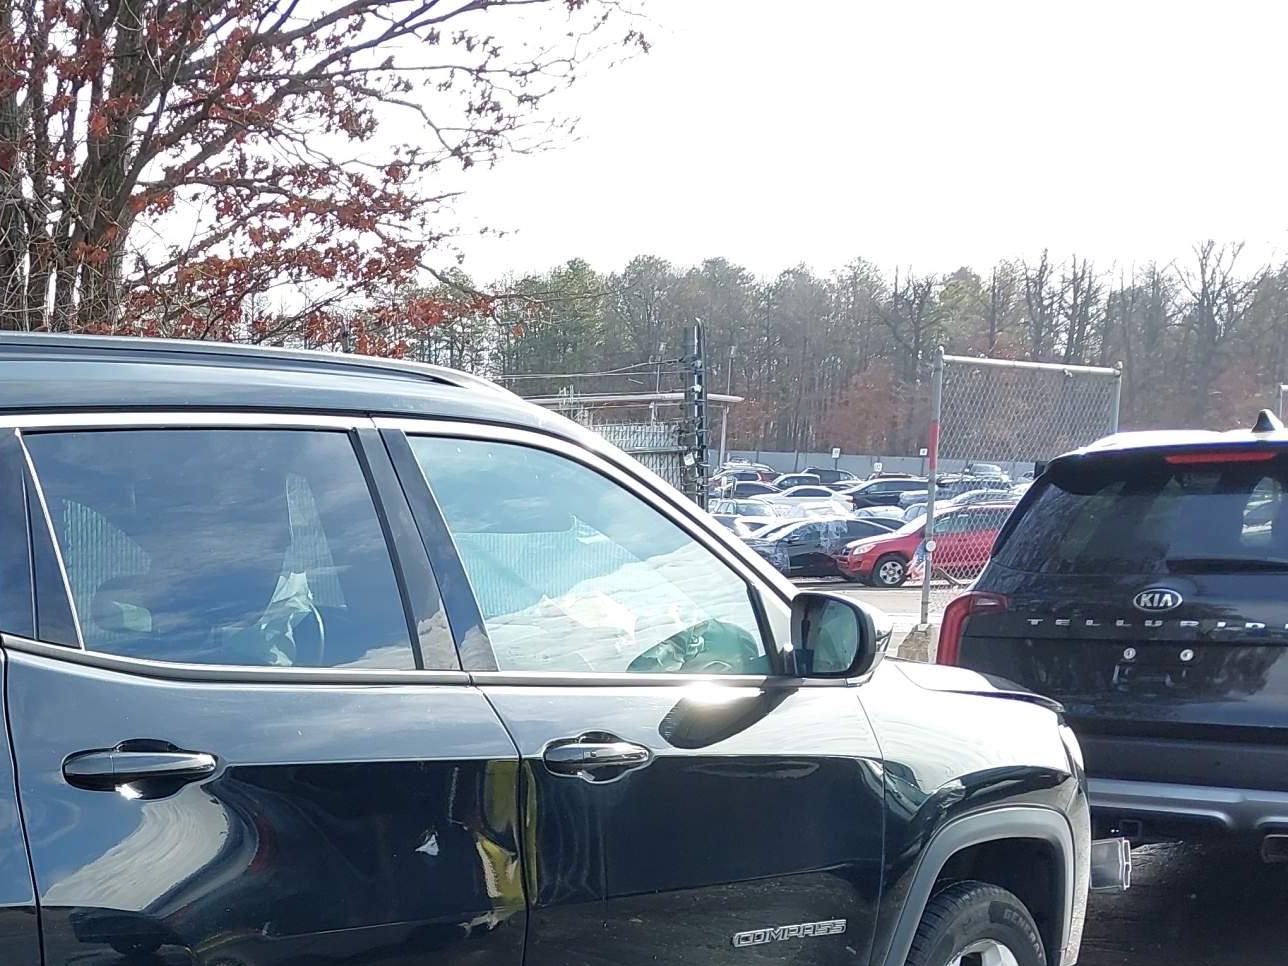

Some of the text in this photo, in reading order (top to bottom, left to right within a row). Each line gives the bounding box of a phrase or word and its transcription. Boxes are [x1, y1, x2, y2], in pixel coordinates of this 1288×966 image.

[1139, 593, 1174, 608] KIA
[1027, 618, 1288, 632] TELLURID
[732, 918, 847, 948] COMPASS
